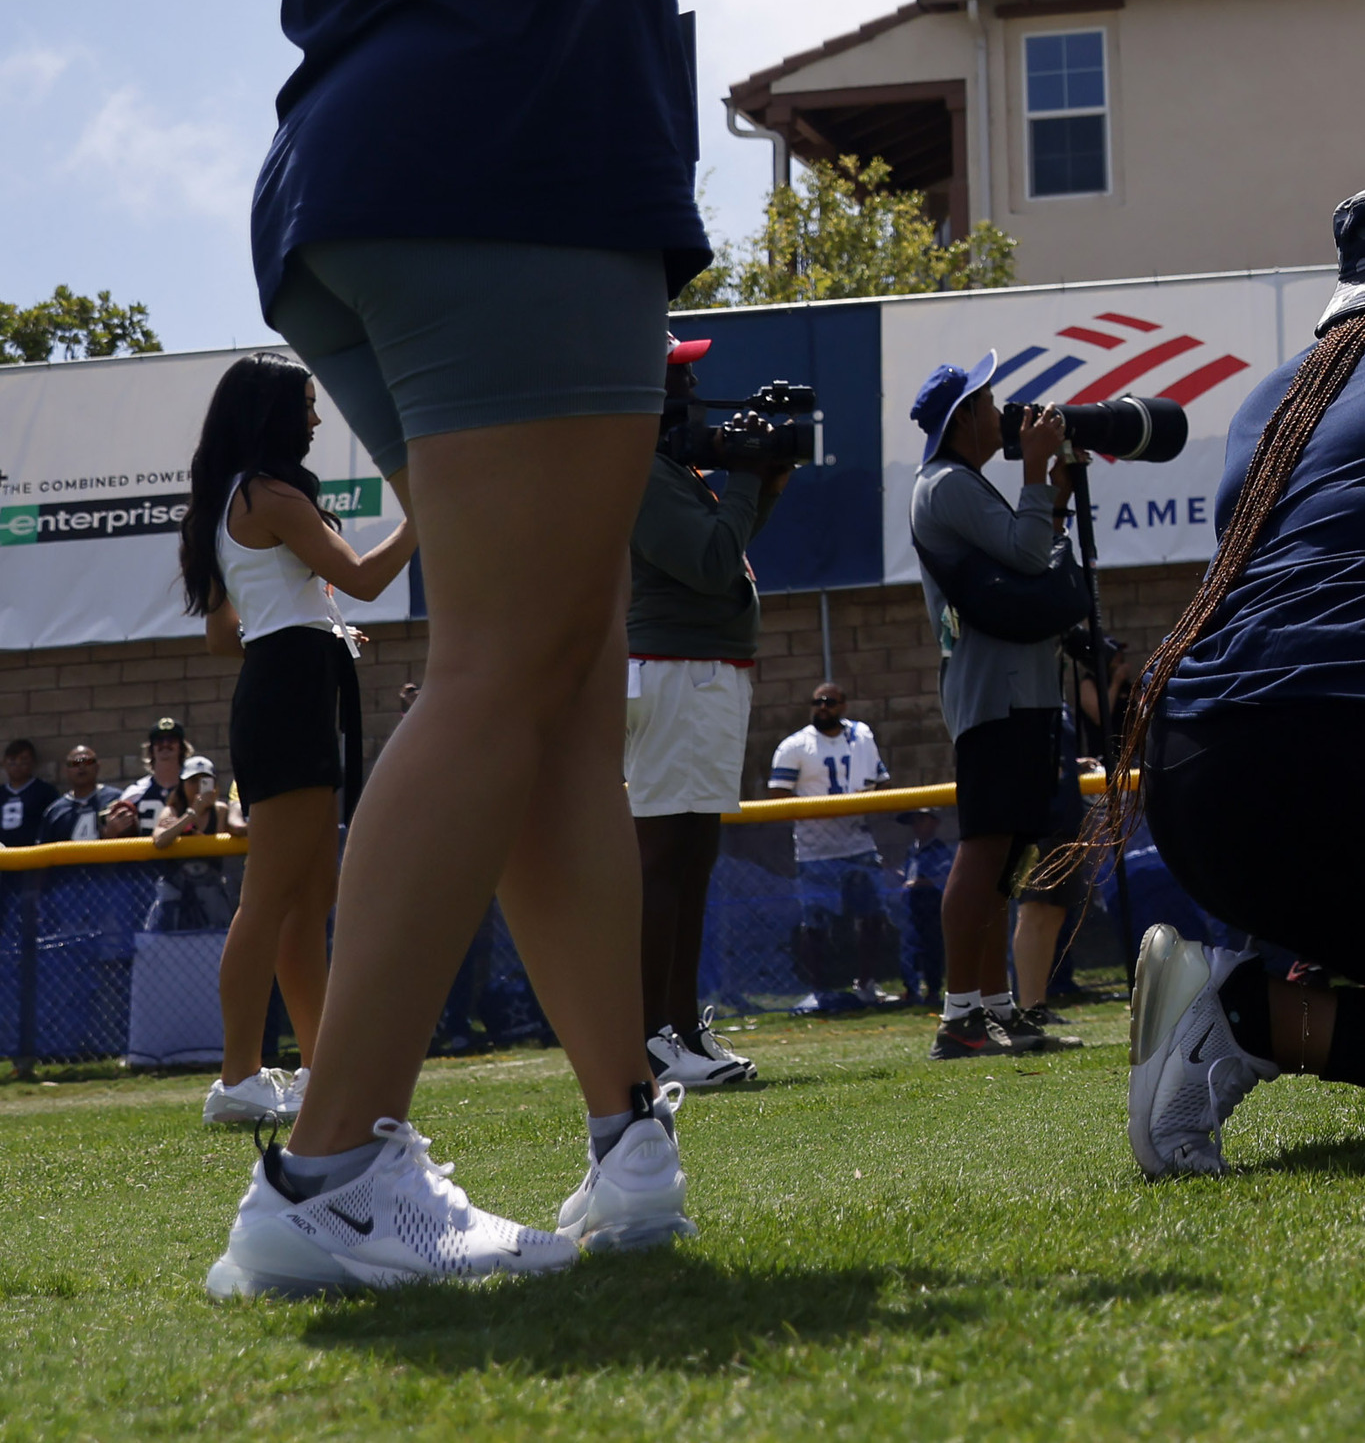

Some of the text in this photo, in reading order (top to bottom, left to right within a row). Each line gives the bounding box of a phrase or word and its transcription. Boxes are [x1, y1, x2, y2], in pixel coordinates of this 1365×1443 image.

[3, 483, 32, 495] THE
[39, 475, 129, 493] COMBINED
[8, 501, 188, 534] enterprise
